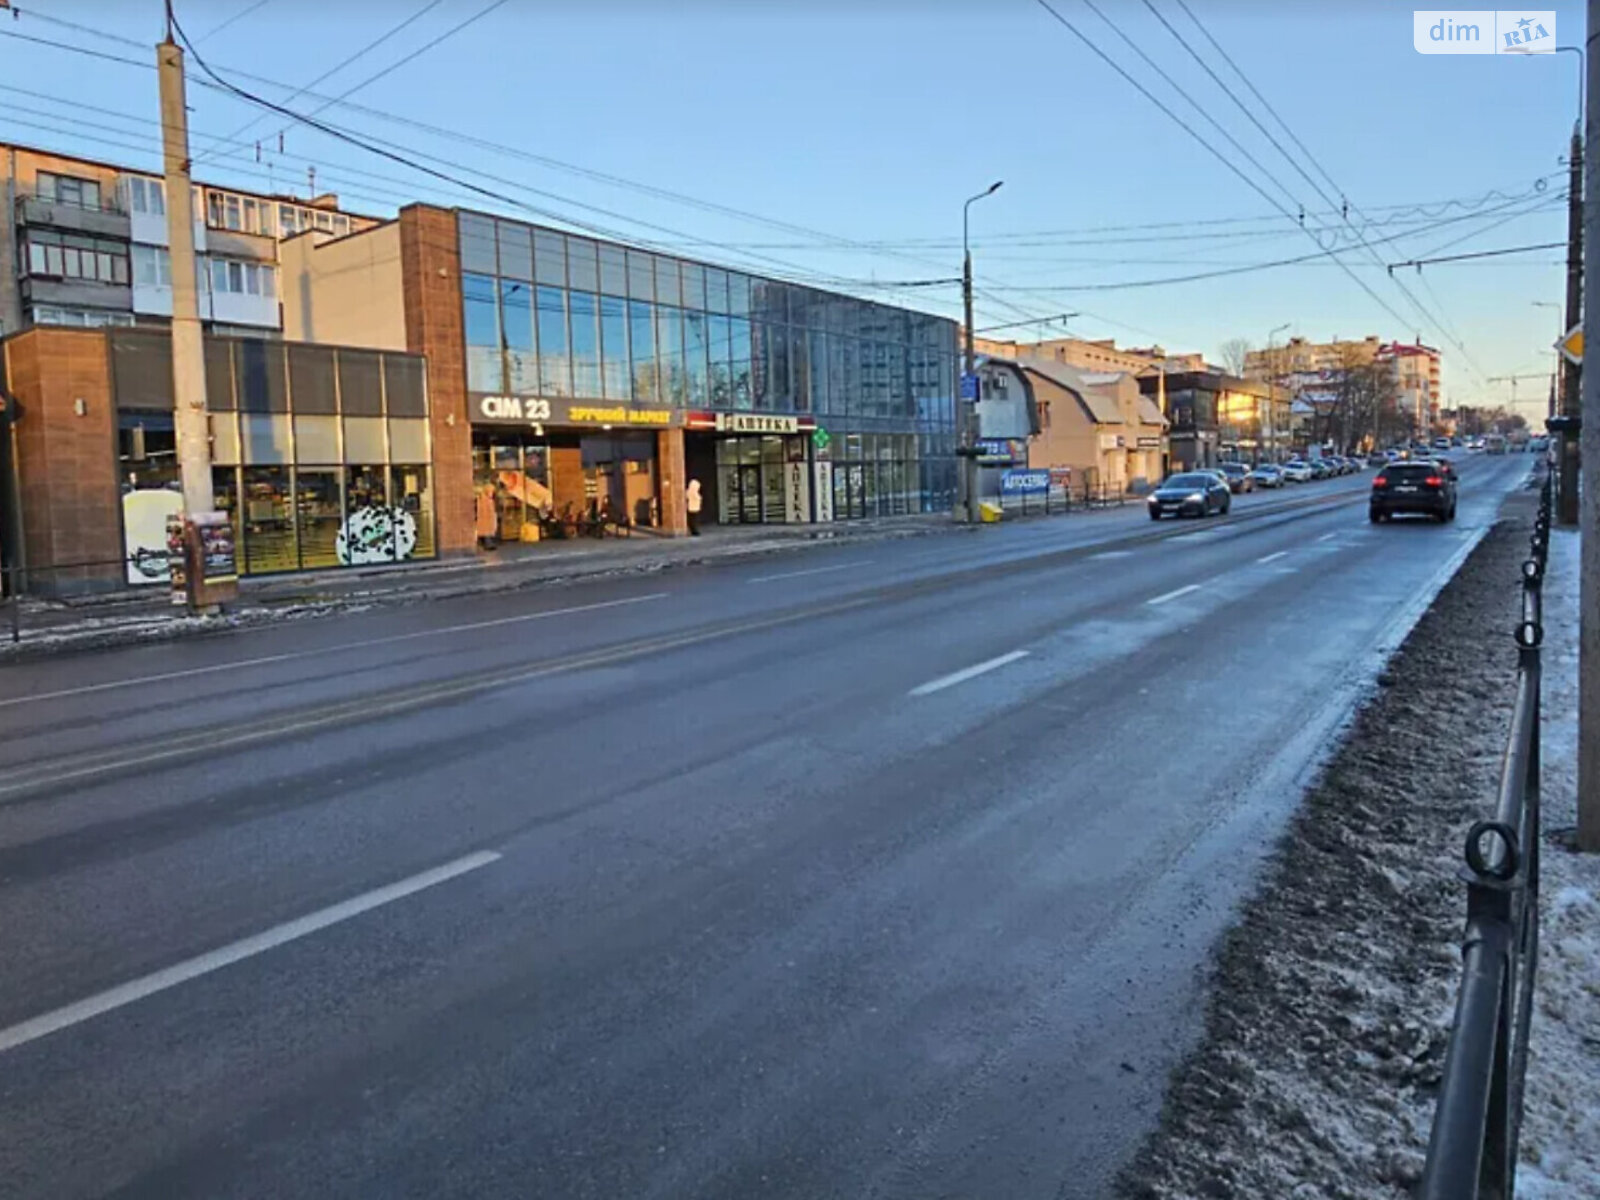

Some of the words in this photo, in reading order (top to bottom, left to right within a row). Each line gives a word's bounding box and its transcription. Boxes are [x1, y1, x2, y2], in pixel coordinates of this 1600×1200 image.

[481, 397, 522, 418] СІМ
[526, 399, 550, 419] 23
[738, 417, 792, 431] АПТЕКА
